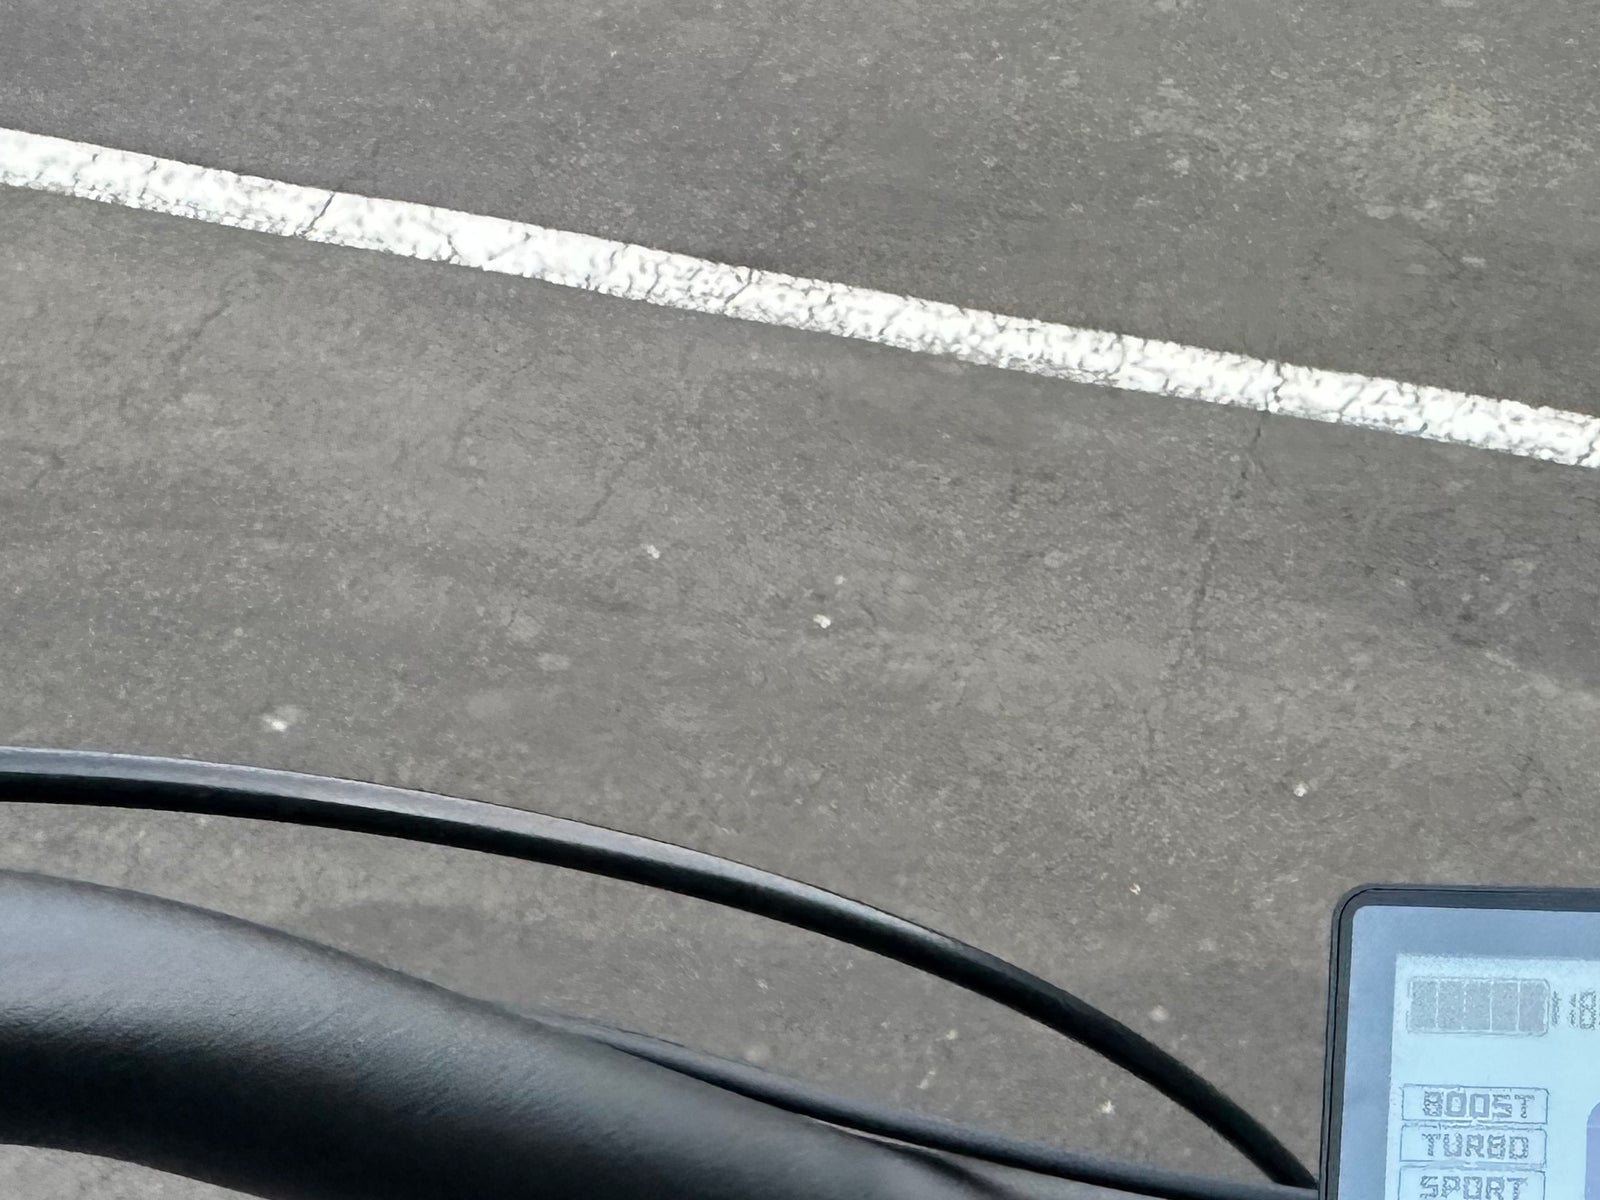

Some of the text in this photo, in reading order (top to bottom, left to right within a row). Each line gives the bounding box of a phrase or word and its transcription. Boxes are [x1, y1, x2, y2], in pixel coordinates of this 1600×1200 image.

[1423, 1091, 1536, 1119] BOOST
[1421, 1133, 1530, 1160] TURBO
[1419, 1175, 1528, 1200] SPORT
